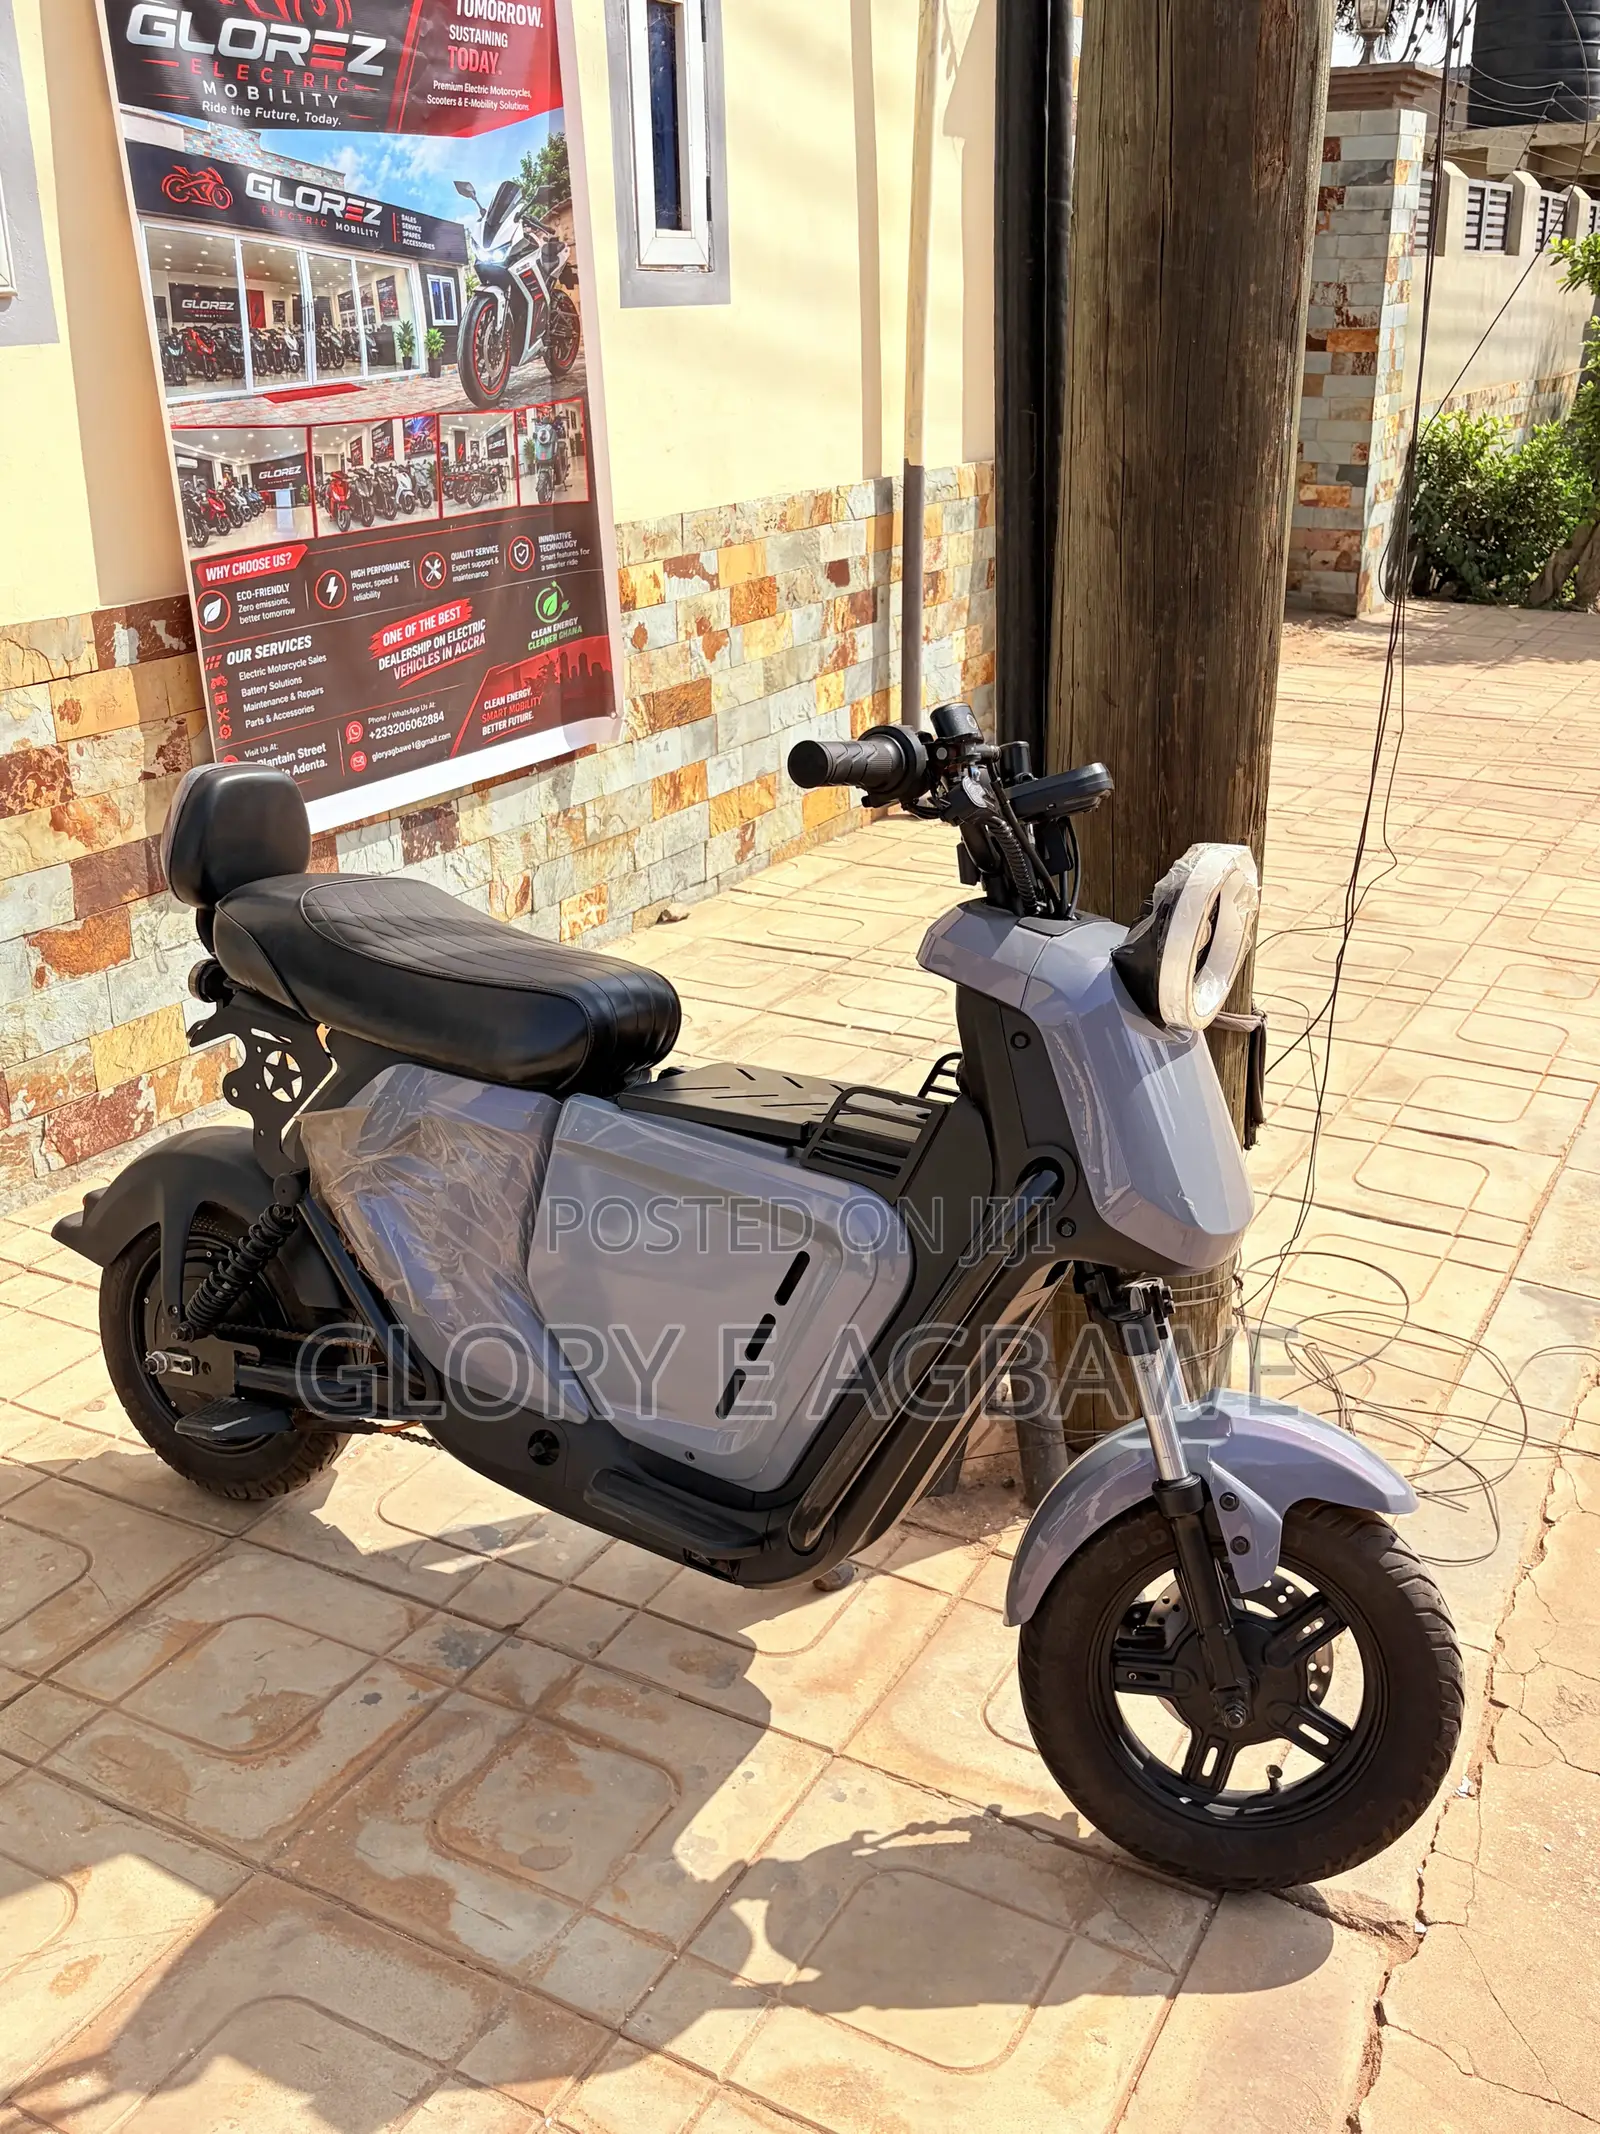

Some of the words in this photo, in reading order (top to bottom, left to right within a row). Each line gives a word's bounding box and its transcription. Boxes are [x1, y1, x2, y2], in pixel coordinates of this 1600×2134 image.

[456, 0, 543, 28] TOMORROW.
[126, 3, 386, 76] GLOREZ
[449, 24, 508, 48] SUSTAINING
[448, 46, 502, 75] TODAY.
[191, 59, 349, 92] ELECTRIC
[203, 80, 338, 108] MOBILITY
[433, 80, 463, 91] Premium
[464, 83, 488, 94] Electric
[490, 86, 532, 98] Motorcycles,
[427, 94, 456, 106] Scooters
[458, 97, 462, 106] &
[464, 98, 498, 111] E-Mobility
[499, 101, 530, 111] Solutions.
[202, 101, 228, 117] Ride
[230, 104, 251, 118] the
[255, 107, 300, 123] Future,
[305, 112, 342, 126] Today.
[245, 172, 382, 226] GLOREZ
[261, 204, 328, 227] ELECTRIC
[336, 222, 379, 238] MOBILITY
[401, 214, 417, 224] SALES
[402, 222, 422, 233] SERVICE
[402, 230, 421, 240] SPARES
[403, 238, 435, 250] ACCESSORIES
[182, 299, 235, 310] GLOREZ
[259, 465, 301, 479] GLOREZ
[538, 531, 572, 544] INNOVATIVE
[539, 540, 577, 553] TECHNOLOGY
[451, 549, 474, 561] QUALITY
[475, 545, 499, 556] SERVICE
[540, 552, 556, 562] Smart
[556, 550, 579, 559] features
[580, 548, 590, 556] for
[206, 564, 230, 581] WHY
[232, 556, 270, 576] CHOOSE
[273, 552, 292, 567] US?
[350, 568, 365, 579] HIGH
[366, 560, 410, 577] PERFORMANCE
[451, 562, 470, 572] Expert
[471, 558, 494, 570] support
[494, 557, 499, 565] &
[546, 561, 565, 570] smarter
[567, 558, 578, 567] ride
[352, 581, 373, 591] Power,
[374, 577, 393, 588] speed
[394, 575, 399, 583] &
[453, 570, 489, 583] maintenance
[236, 583, 290, 601] ECO-FRIENDLY
[353, 590, 381, 602] reliability
[238, 604, 254, 613] Zero
[255, 597, 291, 610] emissions,
[239, 614, 260, 625] better
[262, 607, 295, 620] tomorrow
[383, 628, 403, 647] ONE
[405, 622, 418, 638] OF
[419, 615, 436, 632] THE
[438, 606, 461, 625] BEST
[531, 625, 552, 639] CLEAN
[553, 617, 578, 632] ENERGY
[379, 640, 432, 671] DEALERSHIP
[433, 635, 445, 649] ON
[447, 618, 486, 644] ELECTRIC
[528, 633, 558, 650] CLEANER
[559, 625, 583, 639] GHANA
[226, 648, 252, 665] OUR
[255, 635, 311, 659] SERVICES
[394, 651, 440, 680] VEHICLES
[442, 645, 452, 660] IN
[454, 632, 486, 656] ACCRA
[239, 668, 266, 681] Electric
[267, 659, 306, 674] Motorcycle
[308, 654, 327, 665] Sales
[241, 685, 267, 698] Battery
[269, 676, 303, 691] Solutions
[243, 696, 288, 713] Maintenance
[290, 693, 296, 701] &
[297, 687, 324, 699] Repairs
[482, 707, 507, 723] SMART
[509, 692, 544, 715] MOBILITY
[484, 696, 505, 710] CLEAN
[507, 686, 532, 703] ENERGY.
[245, 717, 264, 728] Parts
[266, 715, 271, 723] &
[273, 704, 315, 721] Accessories
[368, 715, 387, 724] Phone
[392, 706, 419, 718] WhatsApp
[482, 720, 507, 736] BETTER
[508, 711, 534, 727] FUTURE.
[369, 711, 444, 740] +233206062884
[244, 749, 259, 758] Visit
[260, 746, 268, 754] Us
[270, 743, 279, 751] At:
[297, 743, 327, 759] Street
[293, 759, 328, 776] Adenta.
